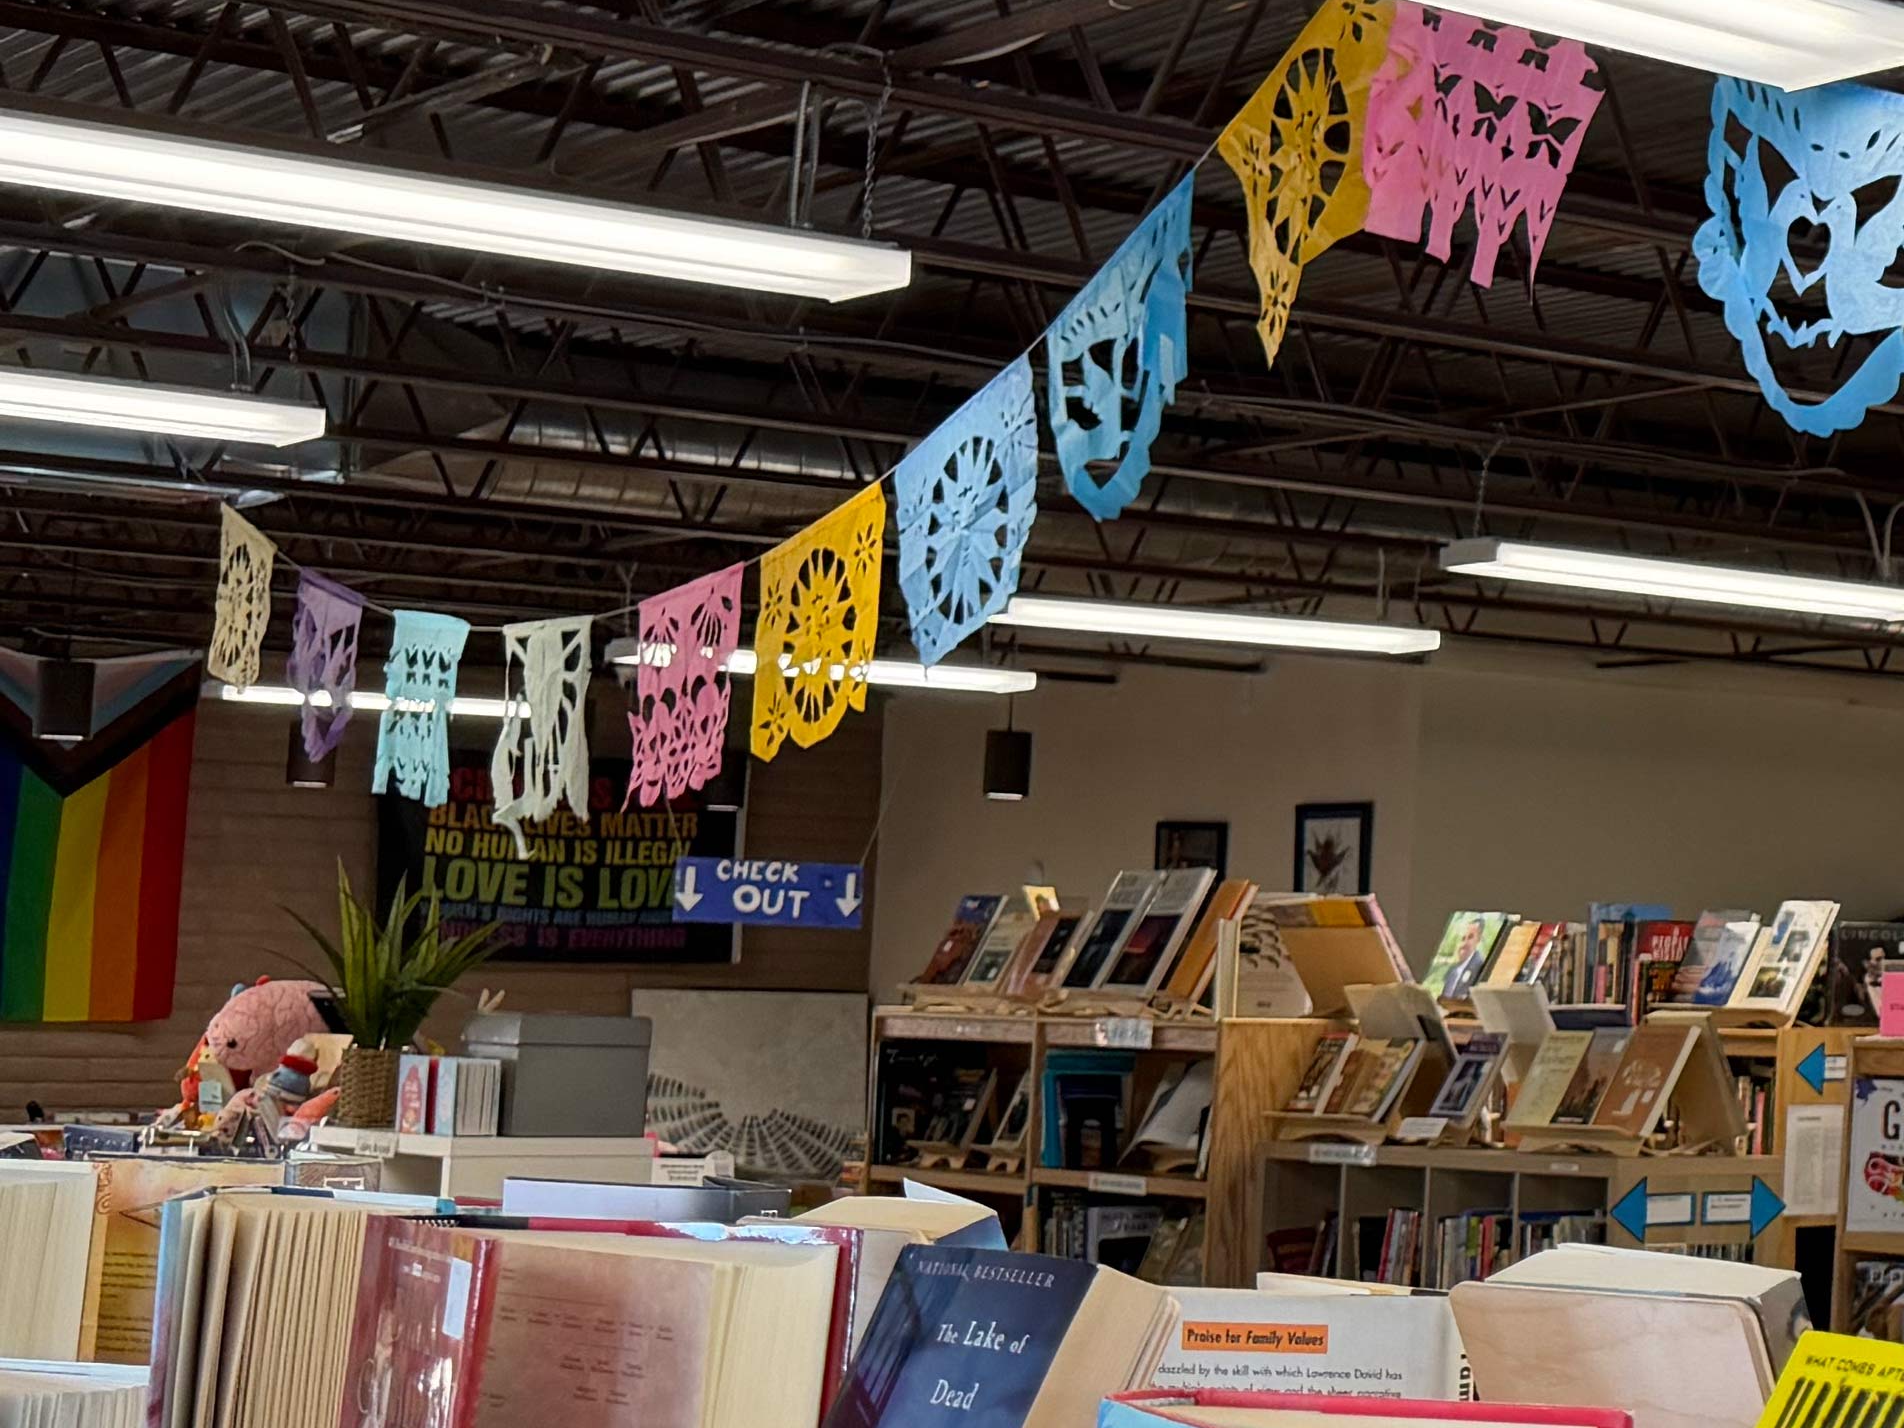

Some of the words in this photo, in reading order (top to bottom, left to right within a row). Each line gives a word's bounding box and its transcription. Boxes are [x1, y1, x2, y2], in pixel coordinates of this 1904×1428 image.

[601, 812, 698, 839] MATTER
[425, 828, 462, 855] NO
[574, 839, 597, 865] IS
[422, 857, 527, 906] LOVE
[544, 864, 584, 909] IS
[598, 867, 677, 910] LOV
[716, 858, 800, 885] CHECK
[733, 885, 810, 918] OUT
[917, 1258, 968, 1279] NATIONAL
[974, 1264, 1055, 1290] BESTSELLER
[936, 1322, 959, 1346] The
[962, 1319, 1006, 1351] Lake
[1009, 1333, 1030, 1356] of
[1186, 1328, 1222, 1344] Praise
[1224, 1329, 1242, 1345] for
[1245, 1329, 1283, 1349] Family
[1287, 1331, 1324, 1348] Values
[1158, 1362, 1195, 1376] dazzled
[1198, 1364, 1211, 1379] by
[1214, 1364, 1229, 1377] the
[1232, 1364, 1249, 1378] skill
[1252, 1366, 1272, 1379] with
[1275, 1366, 1303, 1380] which
[1354, 1367, 1383, 1381] David
[1386, 1369, 1403, 1382] has
[1805, 1354, 1832, 1370] WHAT
[1836, 1357, 1875, 1376] COMES
[929, 1378, 980, 1412] Dead
